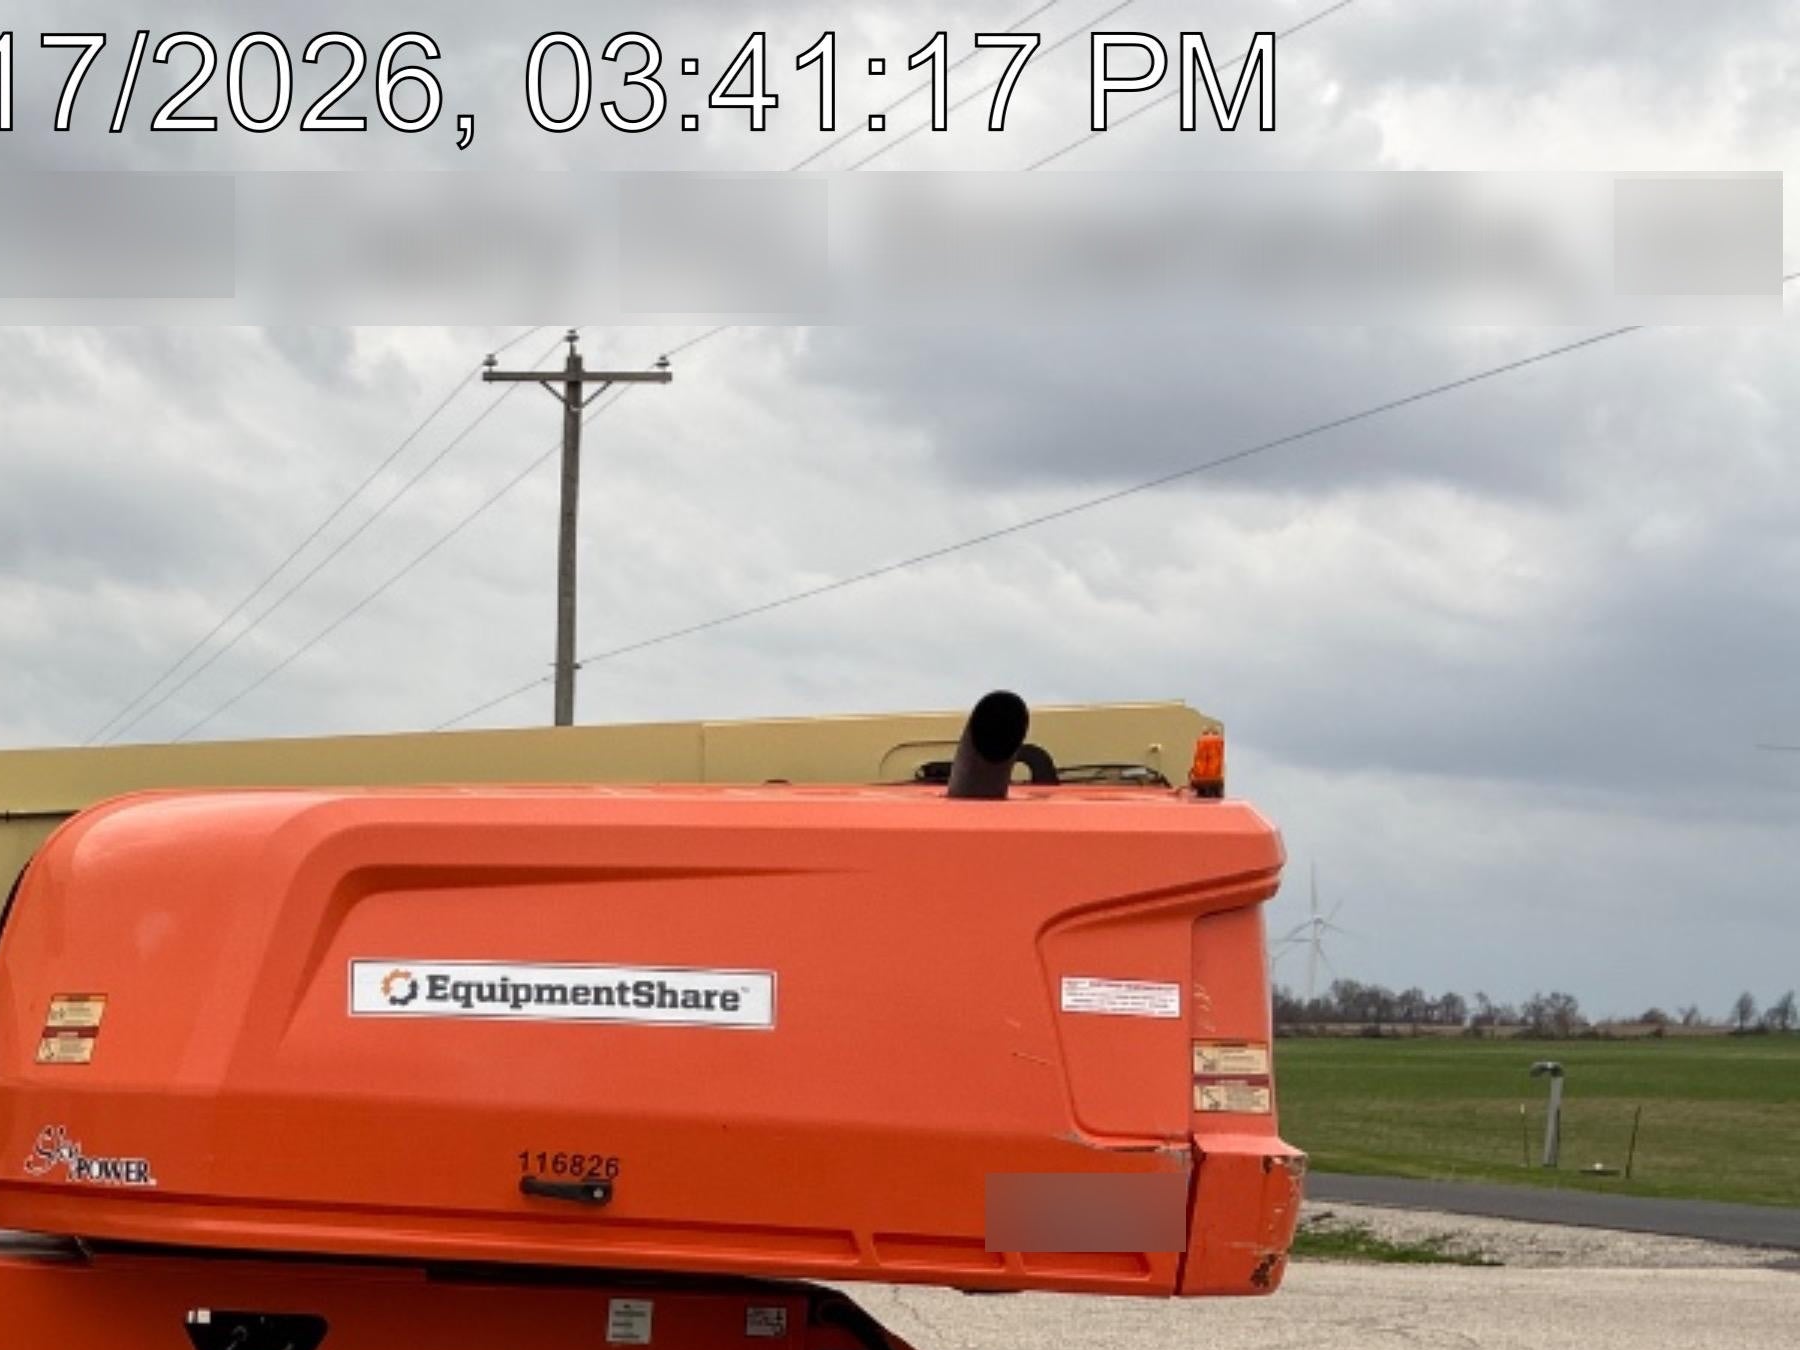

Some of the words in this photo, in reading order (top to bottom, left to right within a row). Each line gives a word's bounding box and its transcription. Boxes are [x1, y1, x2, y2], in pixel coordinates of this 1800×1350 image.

[426, 974, 740, 1012] EquipmentShare
[74, 1157, 150, 1184] POWER
[518, 1150, 620, 1179] 116826
